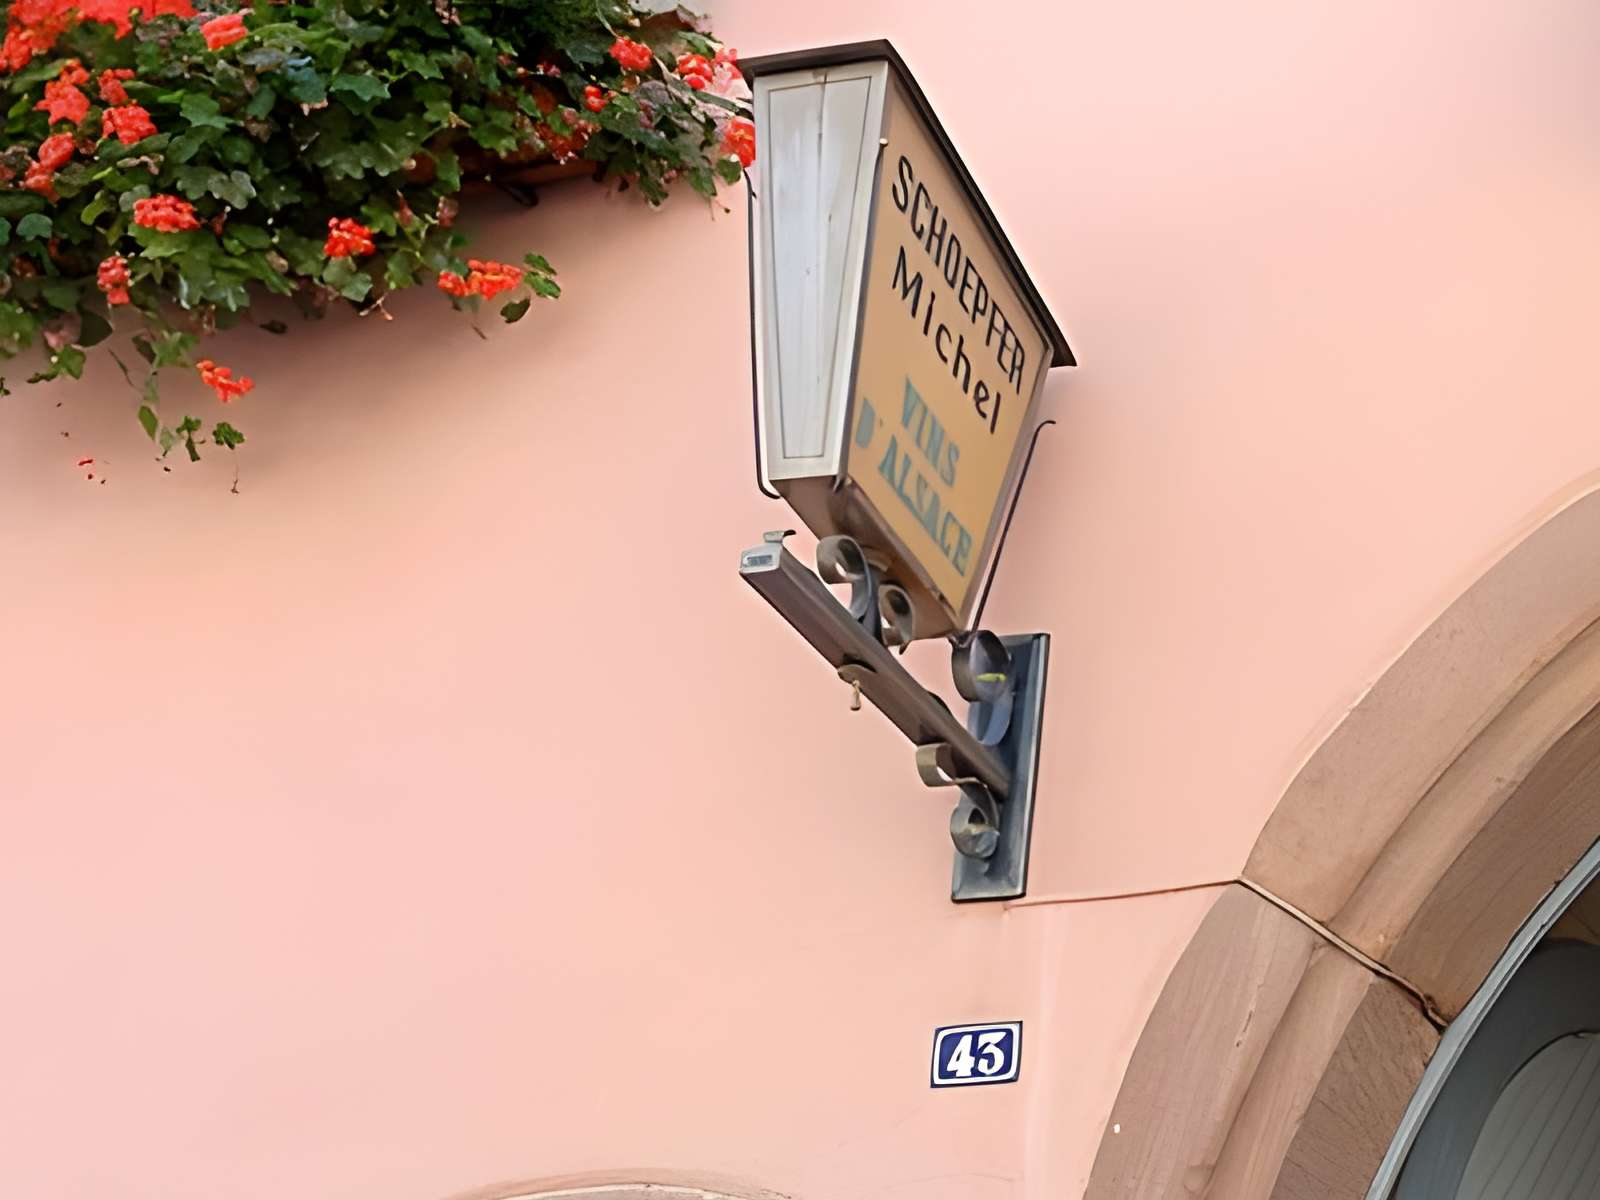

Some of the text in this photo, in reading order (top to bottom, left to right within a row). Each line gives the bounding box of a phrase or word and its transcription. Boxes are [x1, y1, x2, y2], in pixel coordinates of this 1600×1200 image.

[892, 155, 1026, 396] SCHOEPFER
[902, 375, 960, 488] VINS
[946, 1031, 1007, 1077] 43
